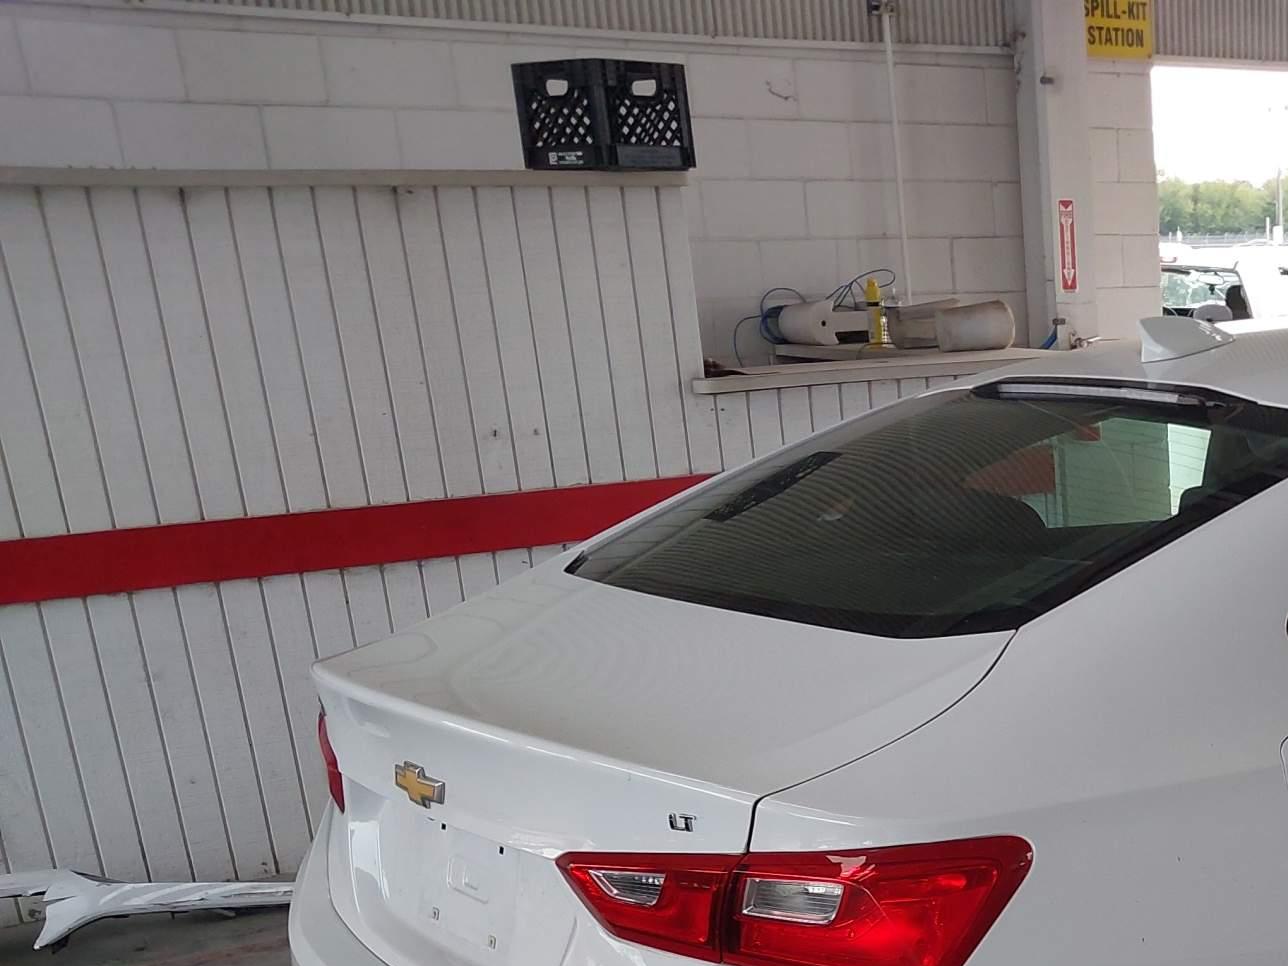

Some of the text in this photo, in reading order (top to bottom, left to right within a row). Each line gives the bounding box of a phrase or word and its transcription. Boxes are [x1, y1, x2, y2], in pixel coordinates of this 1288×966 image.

[1084, 0, 1147, 21] SPILL-KIT
[1087, 25, 1144, 48] STATION
[668, 812, 697, 832] LT
